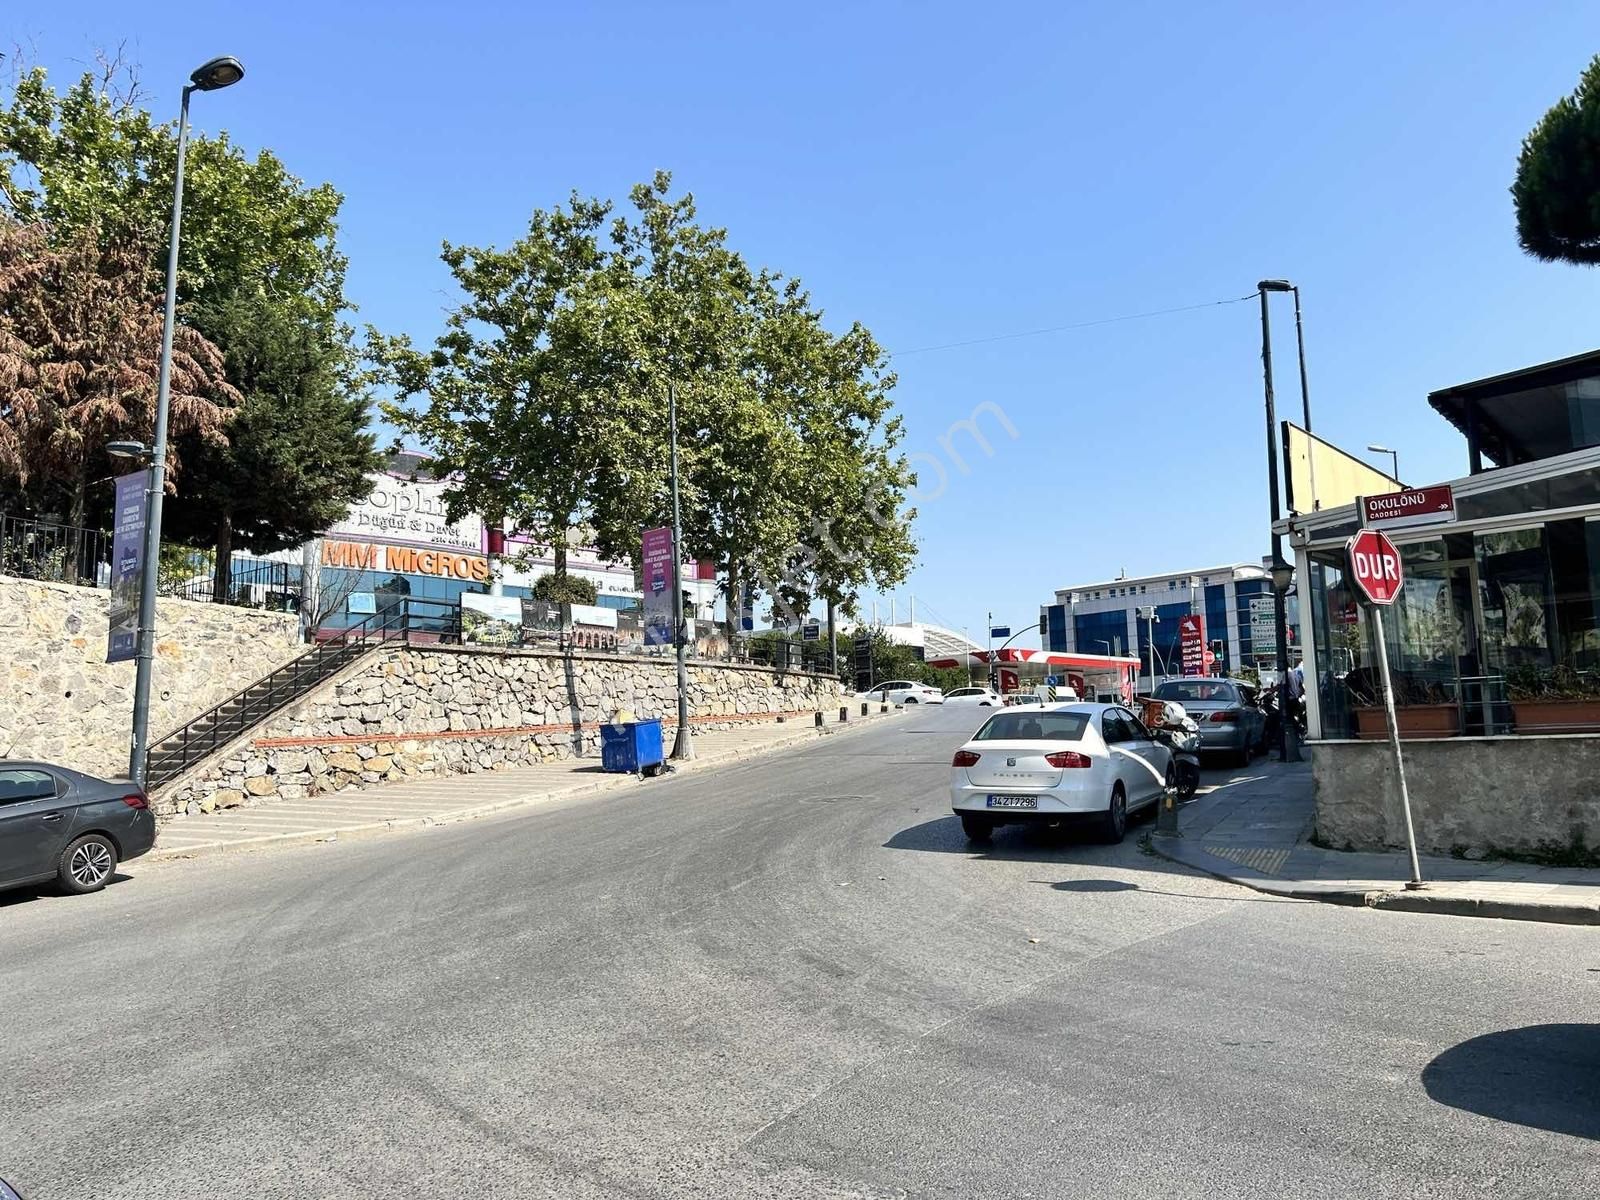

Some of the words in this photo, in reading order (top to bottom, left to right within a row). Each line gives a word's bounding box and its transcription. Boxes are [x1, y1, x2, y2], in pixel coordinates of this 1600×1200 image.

[1369, 492, 1426, 511] OKULÖNÜ
[1369, 509, 1401, 520] CADDESİ
[357, 509, 406, 532] Düğün
[409, 519, 422, 532] &
[425, 521, 462, 538] Davet
[321, 539, 379, 570] MM
[386, 546, 489, 581] MiGROS
[1355, 552, 1398, 581] DUR
